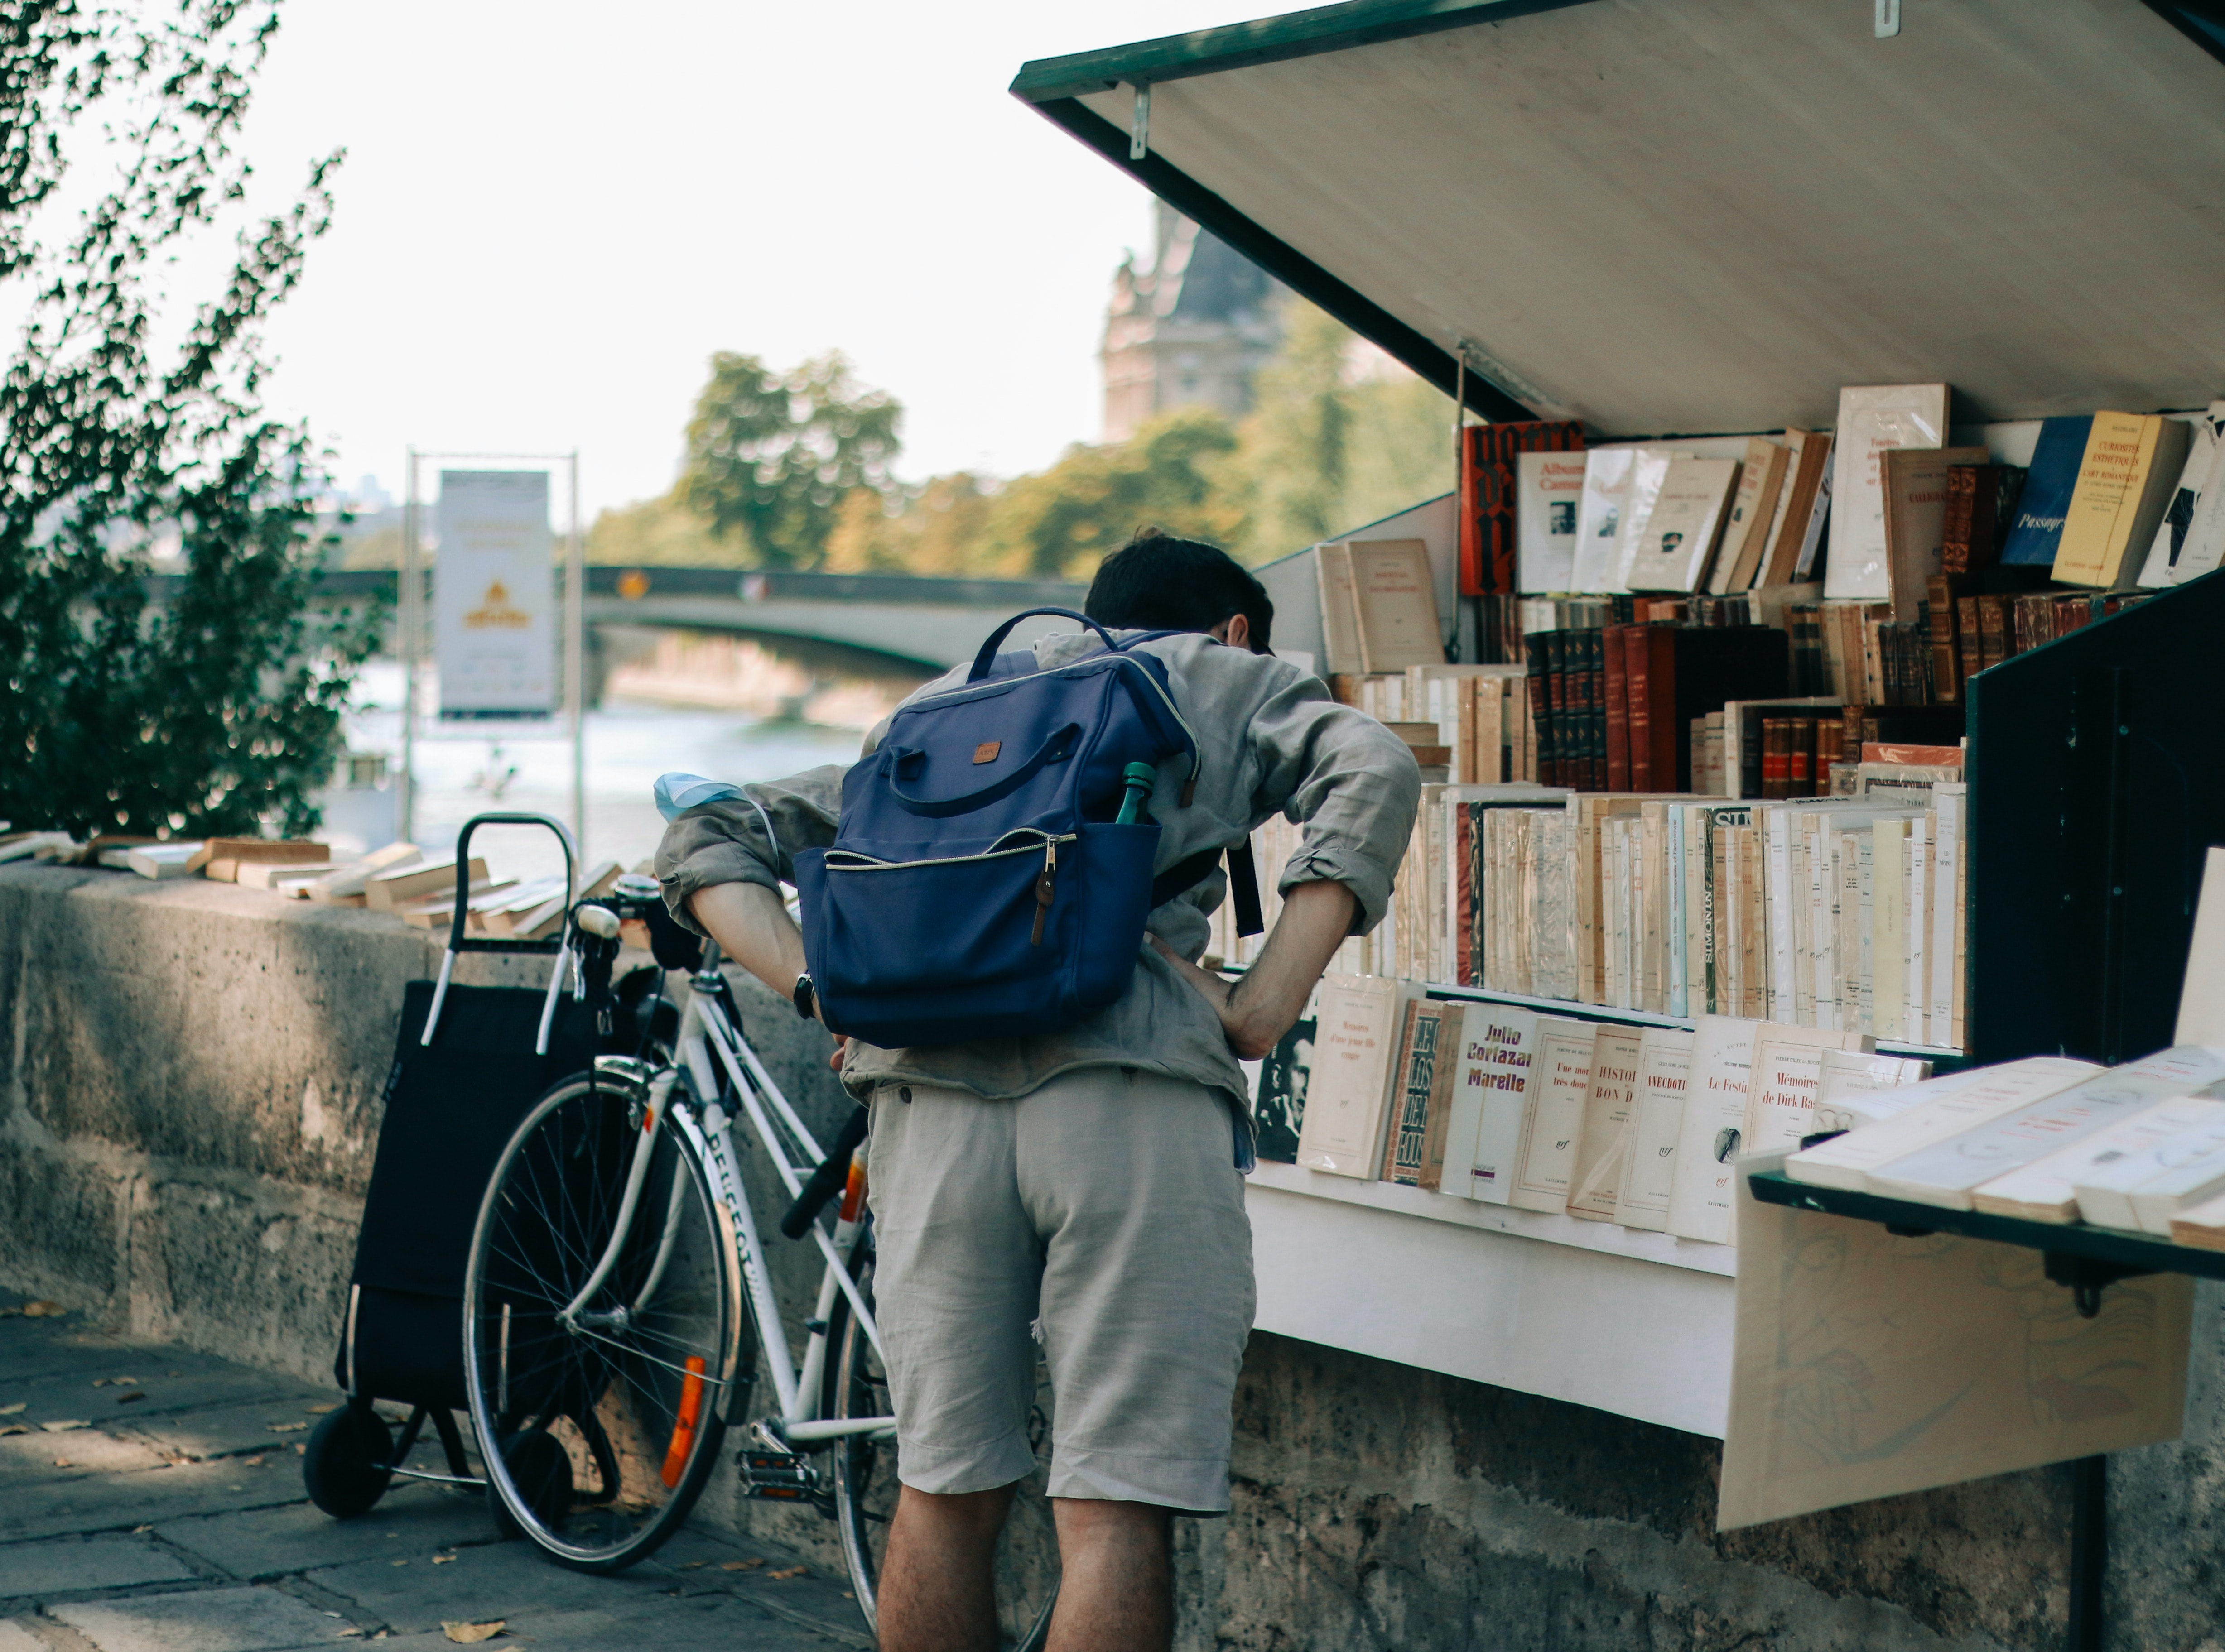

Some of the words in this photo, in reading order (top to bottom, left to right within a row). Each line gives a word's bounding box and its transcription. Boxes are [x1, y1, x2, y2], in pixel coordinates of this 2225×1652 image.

[1705, 891, 1713, 964] SIMONIN
[1484, 1024, 1521, 1046] Julio
[1557, 1062, 1572, 1073] Une
[1468, 1067, 1526, 1093] Marelle
[1554, 1077, 1567, 1086] très
[1709, 1076, 1720, 1090] Le
[1776, 1071, 1819, 1090] Mémoires
[1596, 1086, 1619, 1101] BON
[1625, 1090, 1633, 1103] D
[1763, 1090, 1774, 1105] de
[1777, 1092, 1797, 1109] Dirk
[1556, 1140, 1570, 1150] nrf
[1659, 1147, 1673, 1157] nrf
[1716, 1177, 1729, 1188] nrf
